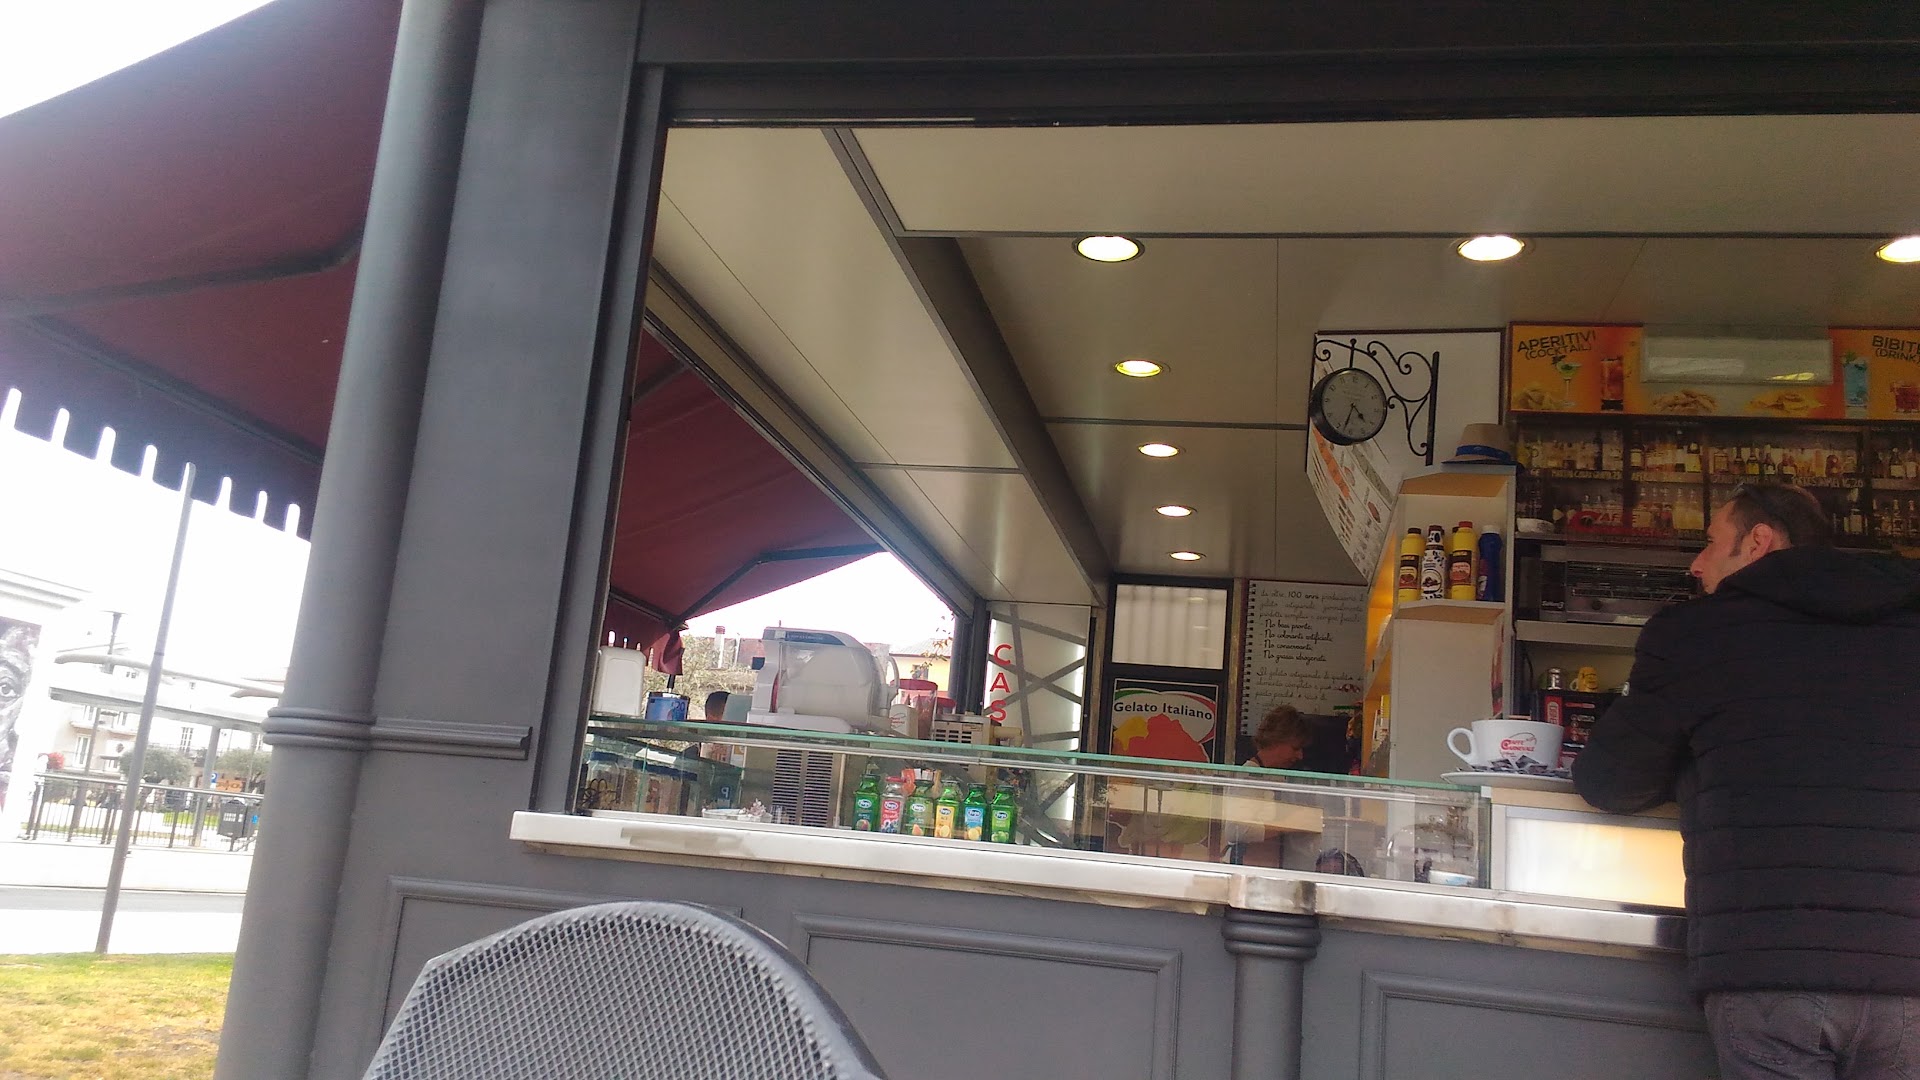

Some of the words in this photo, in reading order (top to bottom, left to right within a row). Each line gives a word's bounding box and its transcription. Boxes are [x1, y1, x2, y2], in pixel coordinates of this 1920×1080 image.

[1517, 330, 1596, 352] APERITIVI
[1525, 341, 1592, 360] (COCKTAIL)
[1288, 591, 1302, 599] 100
[1265, 618, 1276, 629] No
[1264, 628, 1275, 639] No
[1264, 639, 1275, 649] No
[1263, 649, 1275, 659] No
[1113, 702, 1158, 712] Gelato
[1162, 702, 1212, 720] Italiano
